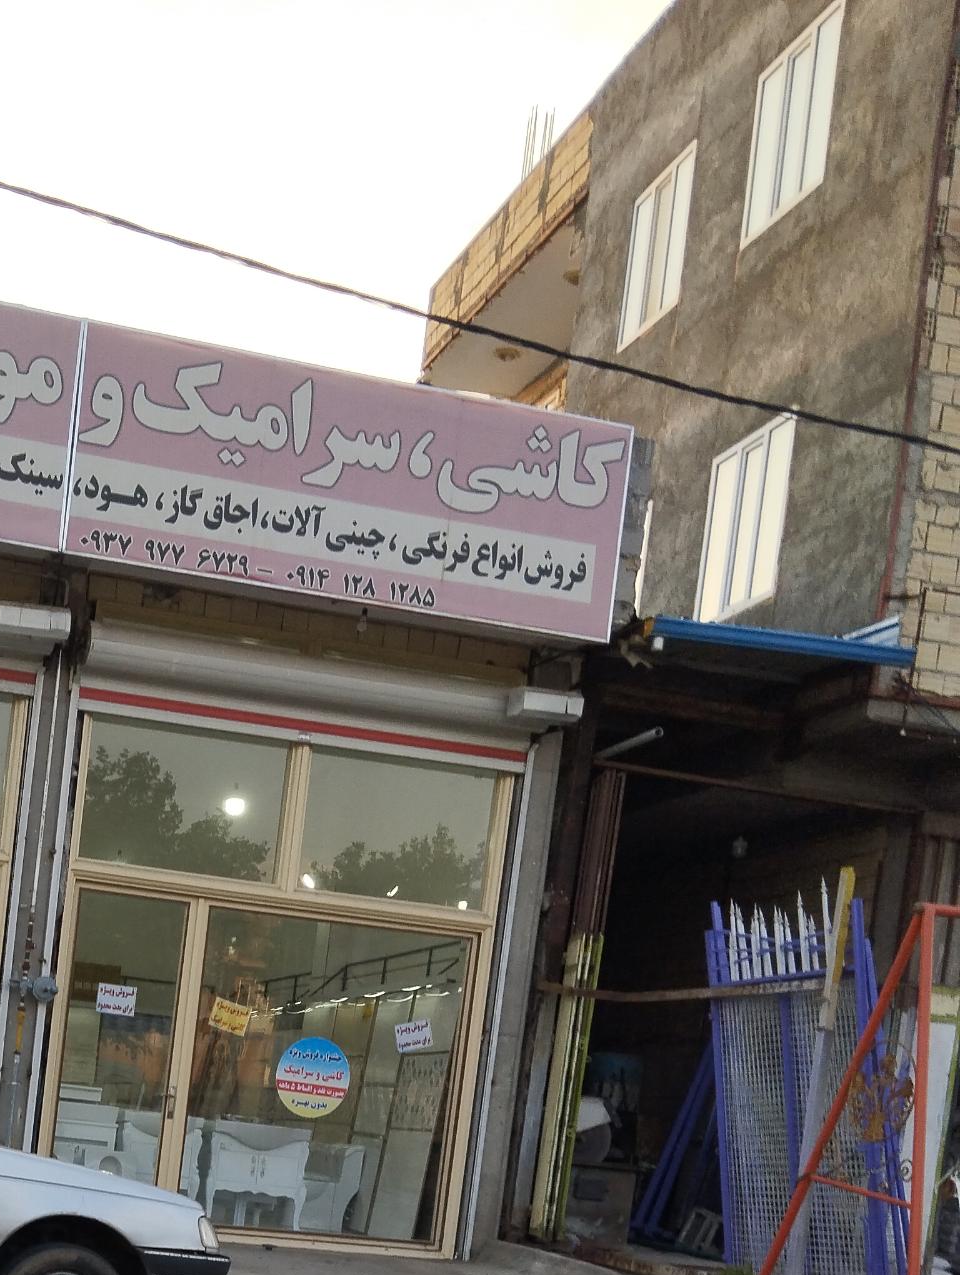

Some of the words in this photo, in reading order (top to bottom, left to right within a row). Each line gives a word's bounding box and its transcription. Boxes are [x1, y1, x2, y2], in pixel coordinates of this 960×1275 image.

[78, 374, 124, 447] و
[133, 362, 401, 488] سرامیک
[203, 493, 259, 535] اجاق
[326, 519, 386, 560] چینی
[471, 540, 524, 580] انواع
[80, 529, 132, 557] ۰۹۳۷
[144, 539, 185, 566] ۹۷۷
[196, 549, 249, 577] ۶۷۲۹
[287, 565, 330, 590] ۰۹۱۴
[343, 573, 376, 599] ۱۲۸
[390, 581, 436, 607] ۱۲۸۵
[524, 551, 587, 591] فروش
